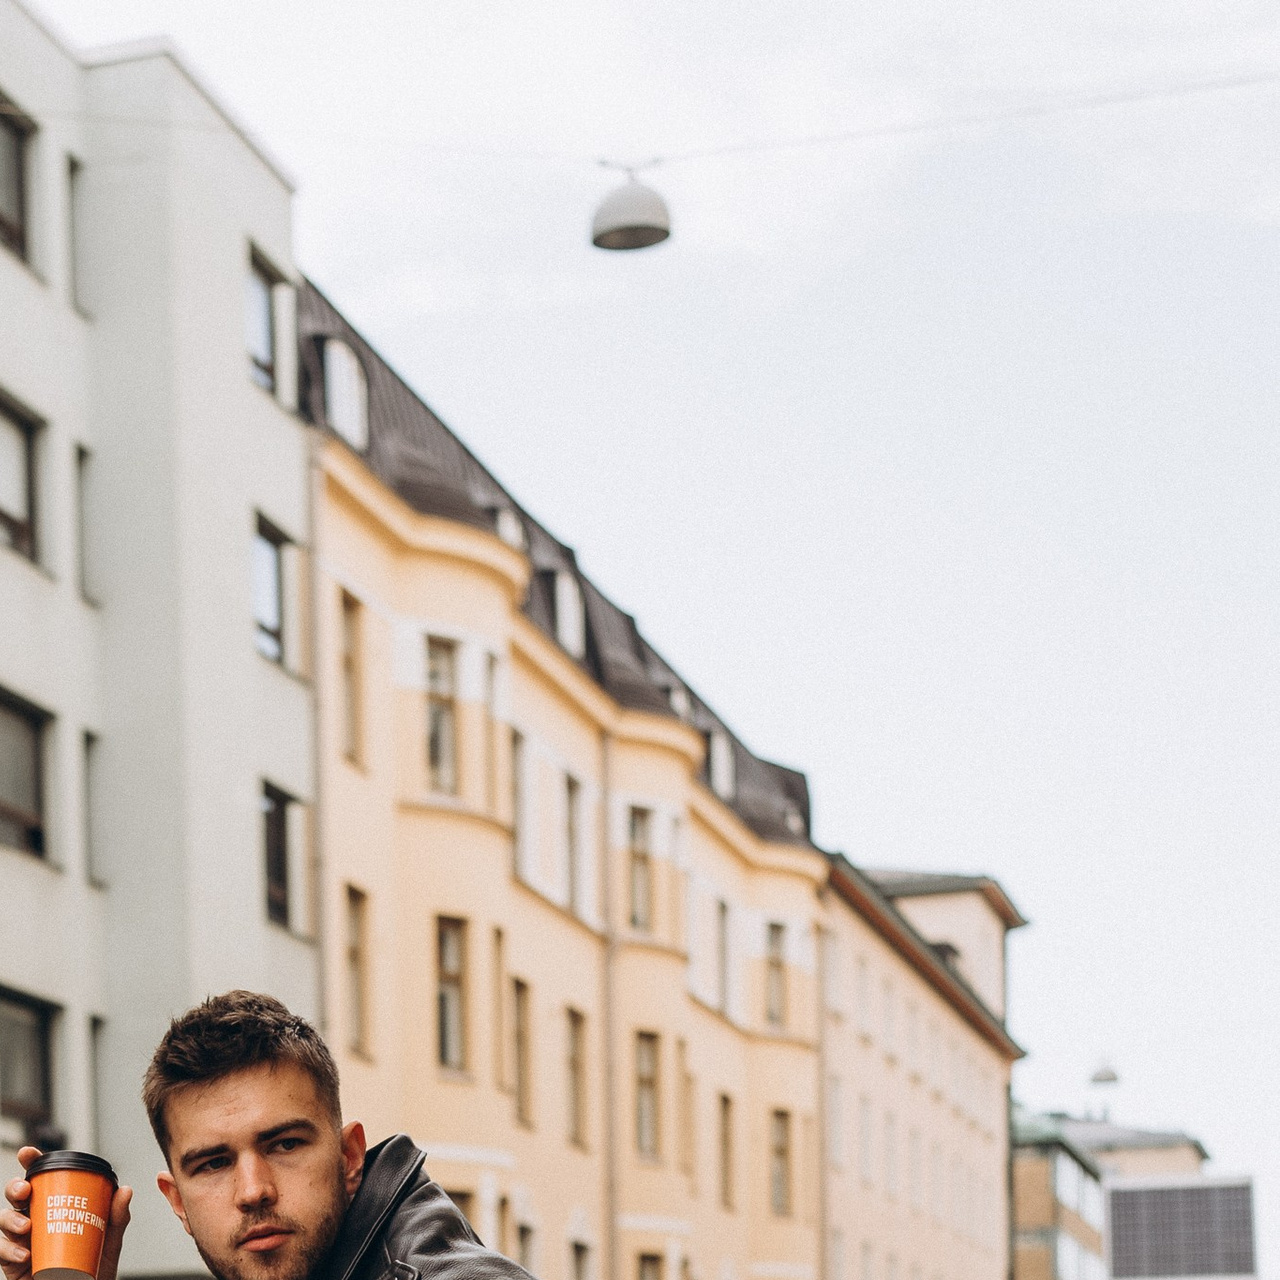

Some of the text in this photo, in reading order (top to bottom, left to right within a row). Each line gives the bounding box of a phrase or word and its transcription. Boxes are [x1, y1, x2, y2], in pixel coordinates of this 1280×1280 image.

[46, 1194, 88, 1210] COFFEE
[46, 1208, 106, 1232] EMPOWERING
[46, 1221, 84, 1236] WOMEN
